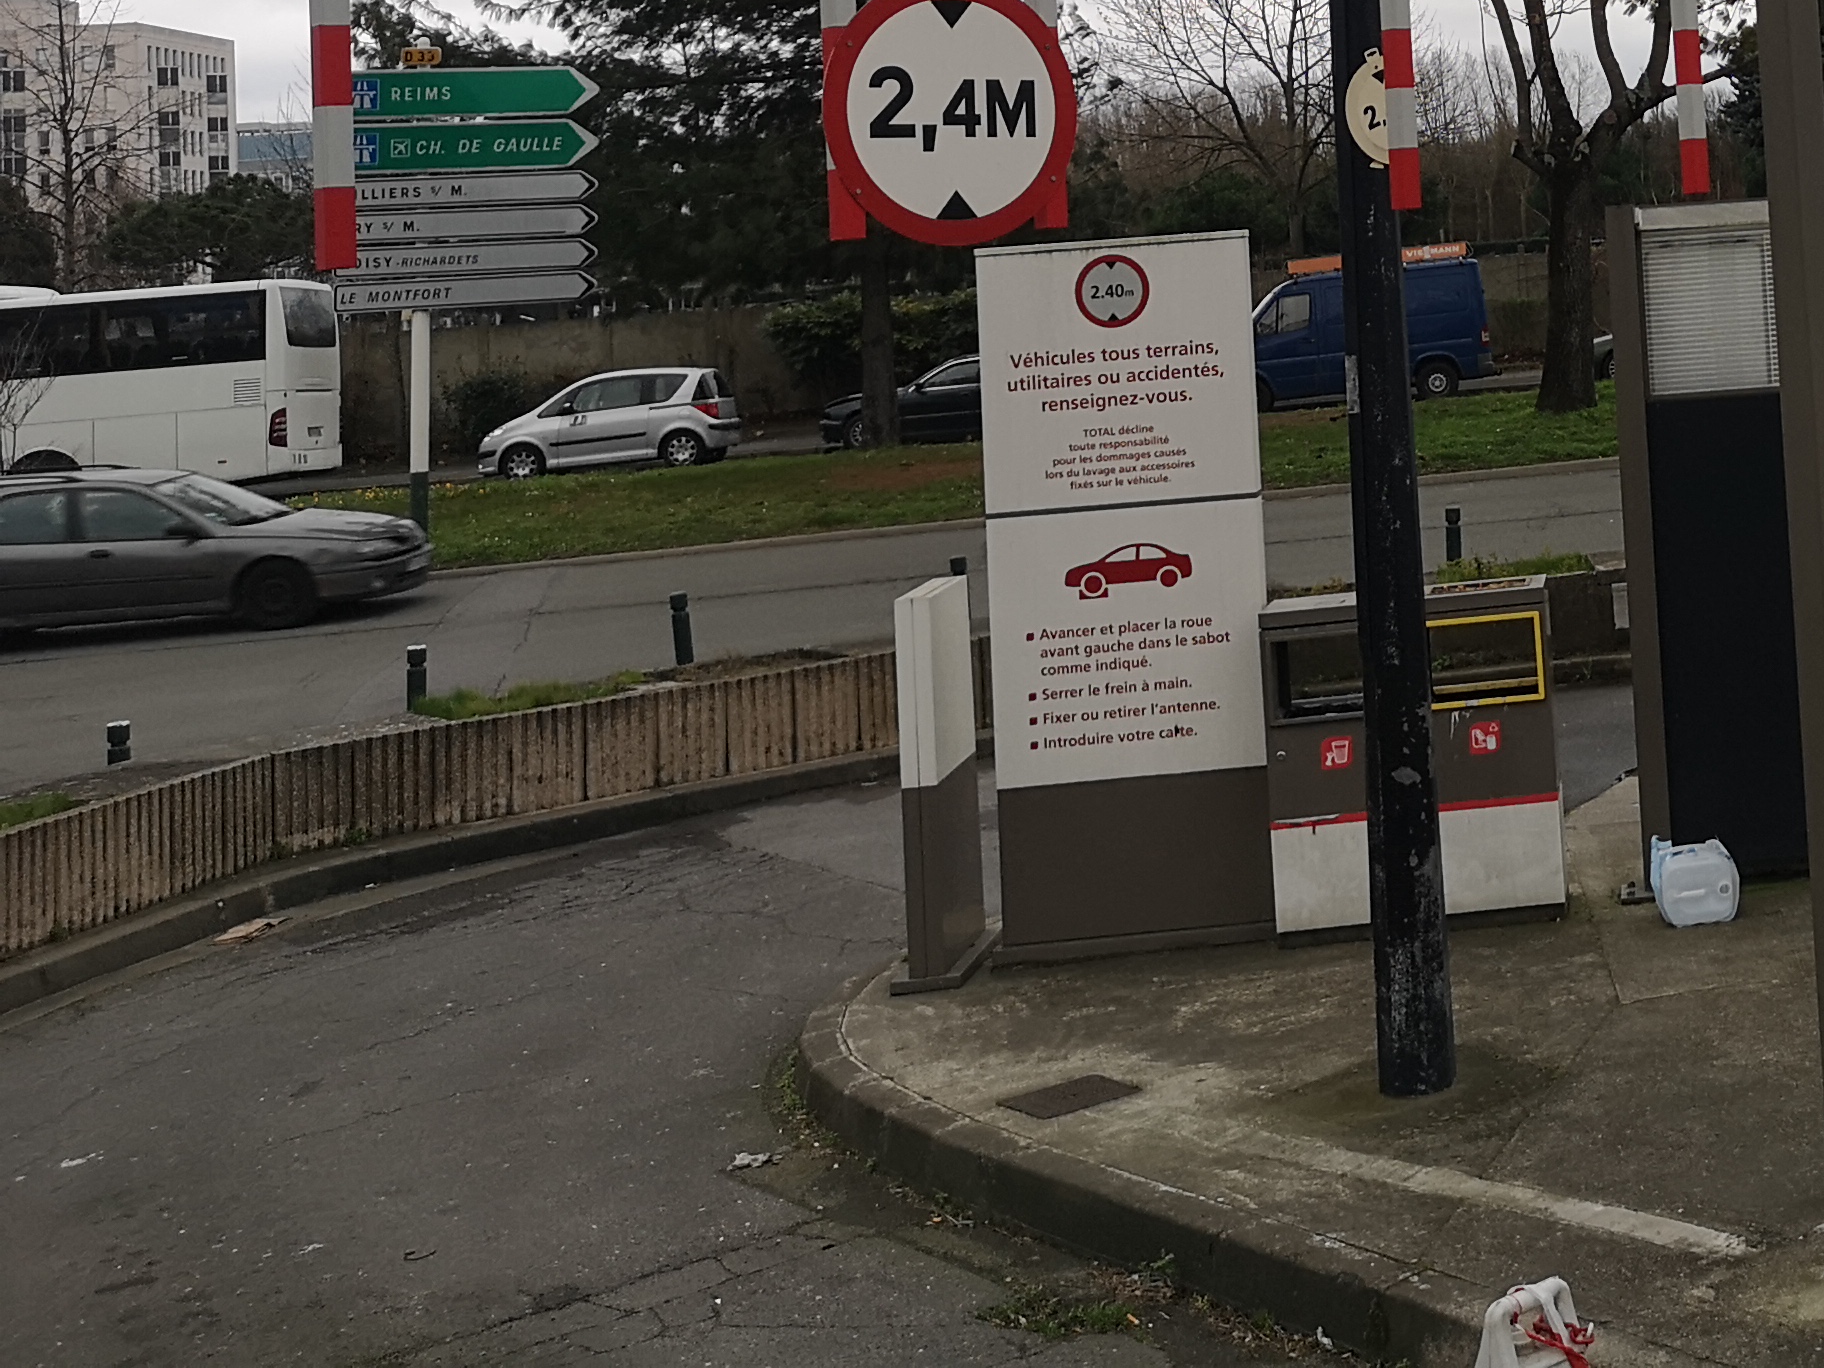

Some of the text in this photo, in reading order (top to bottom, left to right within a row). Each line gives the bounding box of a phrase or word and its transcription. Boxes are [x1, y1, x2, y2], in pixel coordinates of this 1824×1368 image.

[390, 86, 451, 102] REIMS
[869, 65, 1036, 152] 2,4M
[1363, 105, 1387, 131] 2,
[416, 137, 563, 155] CH. DE GAULLE
[355, 186, 422, 201] LLIERS
[355, 221, 374, 234] RY
[402, 220, 420, 233] M.
[340, 287, 453, 305] LE MONTFORT
[1090, 283, 1135, 300] 2.40m
[1009, 340, 1220, 370] Véhicules tous terrains,
[1007, 361, 1225, 393] utilitaires ou accidentés,
[1041, 388, 1194, 413] renseignez-vous.
[1083, 424, 1155, 438] TOTAL décline
[1068, 435, 1170, 452] toute responsabilité
[1052, 447, 1187, 468] pour les dommages causés
[1045, 459, 1196, 480] lors du lavage aux accessoires
[1070, 478, 1094, 490] fixés
[1096, 479, 1113, 488] sur
[1115, 477, 1124, 487] le
[1039, 616, 1213, 642] Avancer et placer la roue
[1040, 631, 1231, 659] avant gauche dans le sabot
[1040, 655, 1152, 677] comme indiqué.
[1042, 676, 1193, 701] Serrer le frein à main.
[1043, 698, 1221, 725] Fixer ou retirer l'antenne.
[1043, 732, 1114, 749] Introduire
[1118, 728, 1155, 743] votre
